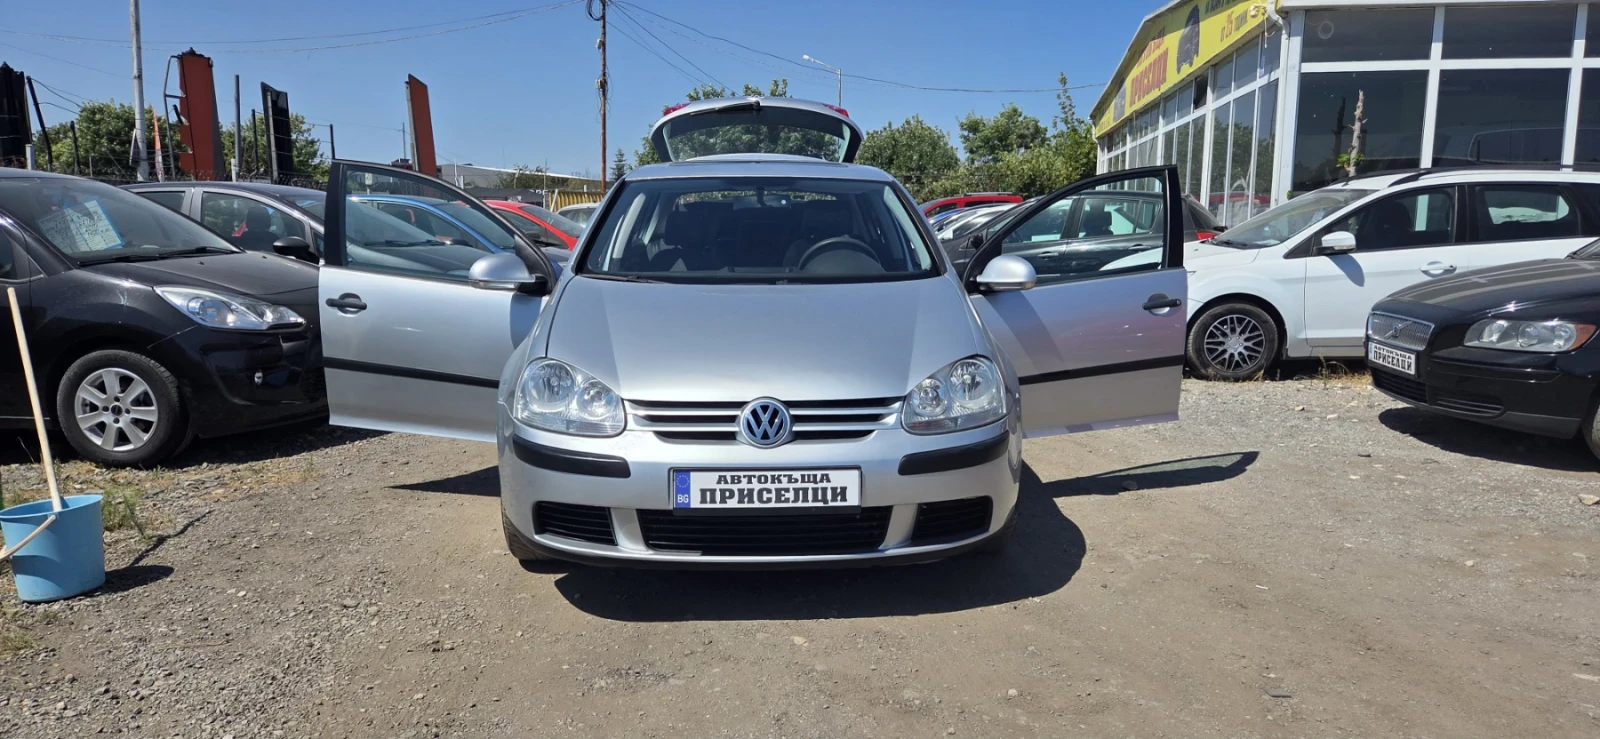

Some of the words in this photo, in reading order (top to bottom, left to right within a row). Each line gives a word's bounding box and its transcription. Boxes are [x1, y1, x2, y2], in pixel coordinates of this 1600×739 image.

[1373, 345, 1412, 361] АВТОКЪЩА
[1373, 351, 1412, 371] ПРИСЕЛЦИ
[716, 473, 831, 485] АВТОКЪЩА
[677, 494, 689, 503] BG
[699, 486, 848, 505] ПРИСЕЛЦИ
